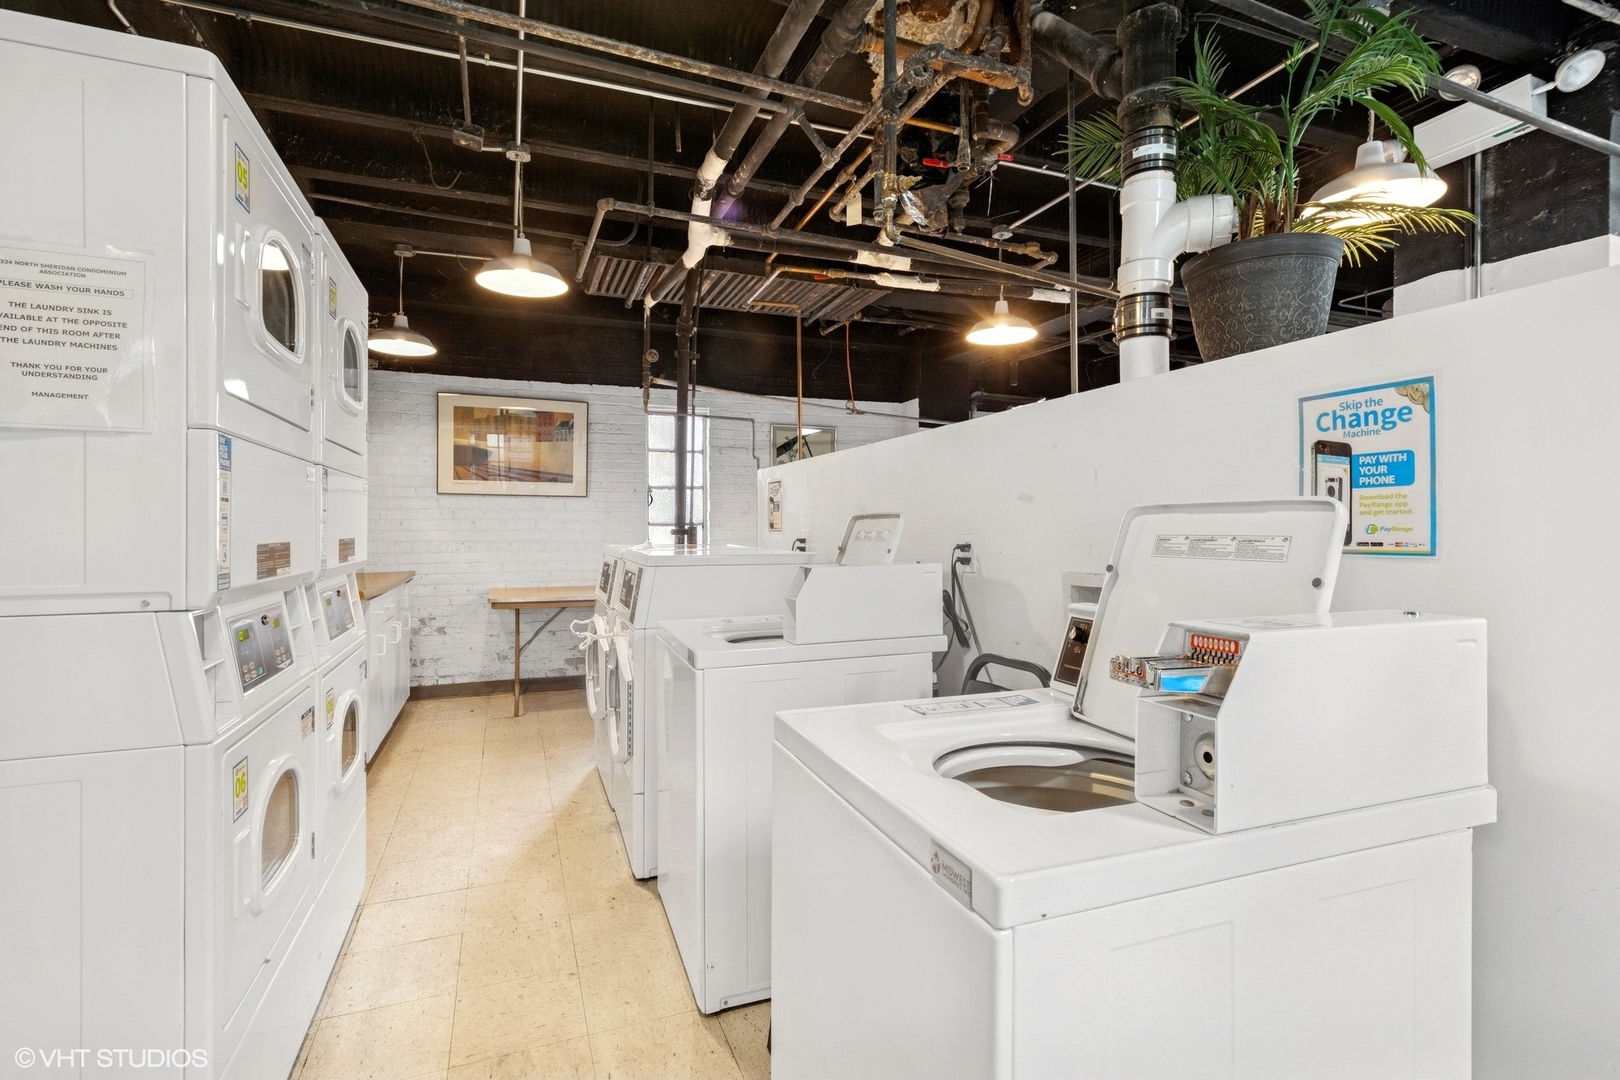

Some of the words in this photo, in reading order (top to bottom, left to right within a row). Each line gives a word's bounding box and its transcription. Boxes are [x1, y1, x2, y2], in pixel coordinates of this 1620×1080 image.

[237, 161, 248, 190] 05
[39, 269, 86, 278] ASSOCIATION
[77, 266, 127, 276] CONDOMINIUM
[35, 283, 63, 291] WASH
[66, 285, 92, 294] YOUR
[94, 288, 125, 297] HANDS
[30, 303, 74, 312] LAUNDRY
[77, 307, 100, 315] SINK
[61, 317, 80, 325] THE
[82, 319, 128, 328] OPPOSITE
[36, 327, 59, 335] THIS
[62, 329, 90, 337] ROOM
[92, 331, 121, 340] AFTER
[0, 336, 19, 344] THE
[22, 338, 67, 347] LAUNDRY
[69, 342, 118, 351] MACHINES
[10, 361, 41, 370] THANK
[65, 365, 83, 373] FOR
[84, 366, 108, 374] YOUR
[21, 371, 98, 380] UNDERSTANDING
[31, 391, 89, 400] MANAGEMENT
[1339, 400, 1363, 412] Skip
[1364, 398, 1384, 408] the
[1316, 405, 1413, 432] Change
[1343, 428, 1381, 439] Machine
[1359, 455, 1378, 465] PAY
[1379, 452, 1407, 464] WITH
[1359, 465, 1388, 475] YOUR
[1359, 475, 1396, 486] PHONE
[1359, 493, 1394, 501] Download
[1373, 509, 1384, 517] get
[1385, 508, 1415, 516] started.
[1380, 525, 1414, 533] PayRange
[235, 772, 246, 799] 06
